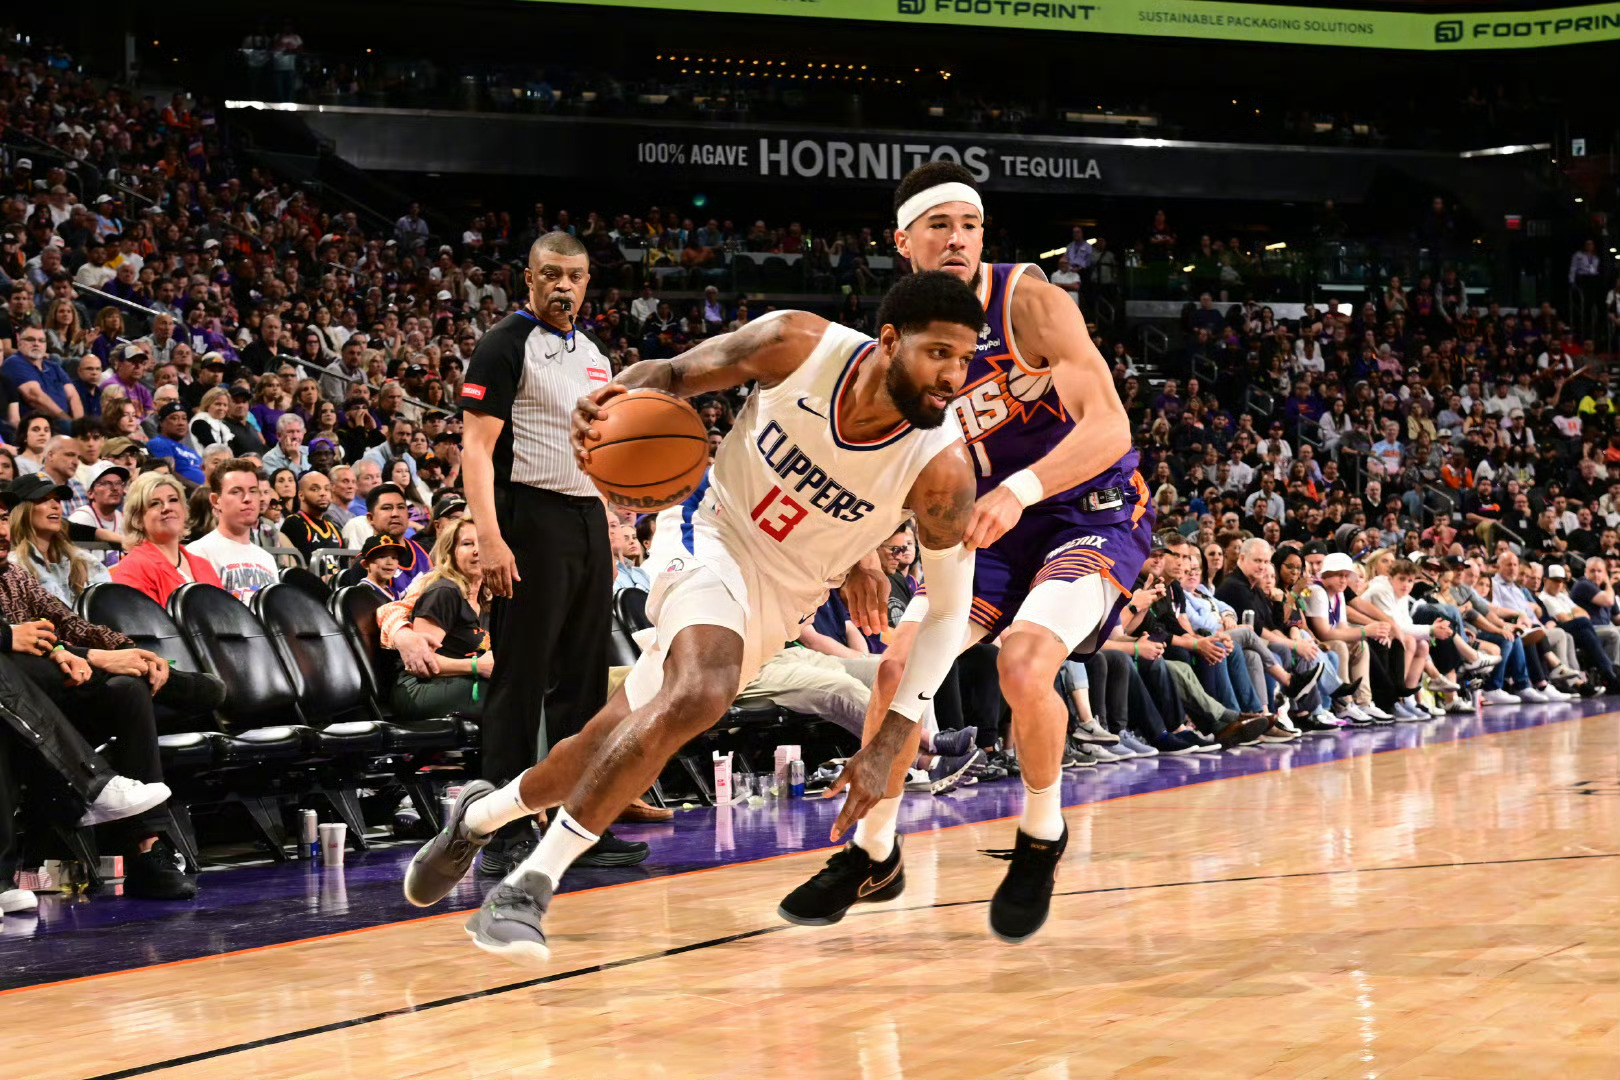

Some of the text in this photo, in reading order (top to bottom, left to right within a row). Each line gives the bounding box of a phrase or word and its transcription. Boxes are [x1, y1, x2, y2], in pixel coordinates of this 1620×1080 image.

[935, 0, 1095, 20] FOOTPRINT
[1138, 11, 1374, 34] SUSTAINABLE PACKAGING SOLUTIONS
[1473, 14, 1620, 38] FOOTPRIN
[638, 143, 685, 165] 100%
[690, 144, 748, 166] AGAVE
[1000, 155, 1101, 179] TEQUILA
[757, 419, 875, 522] CLIPPERS
[751, 485, 809, 543] 13
